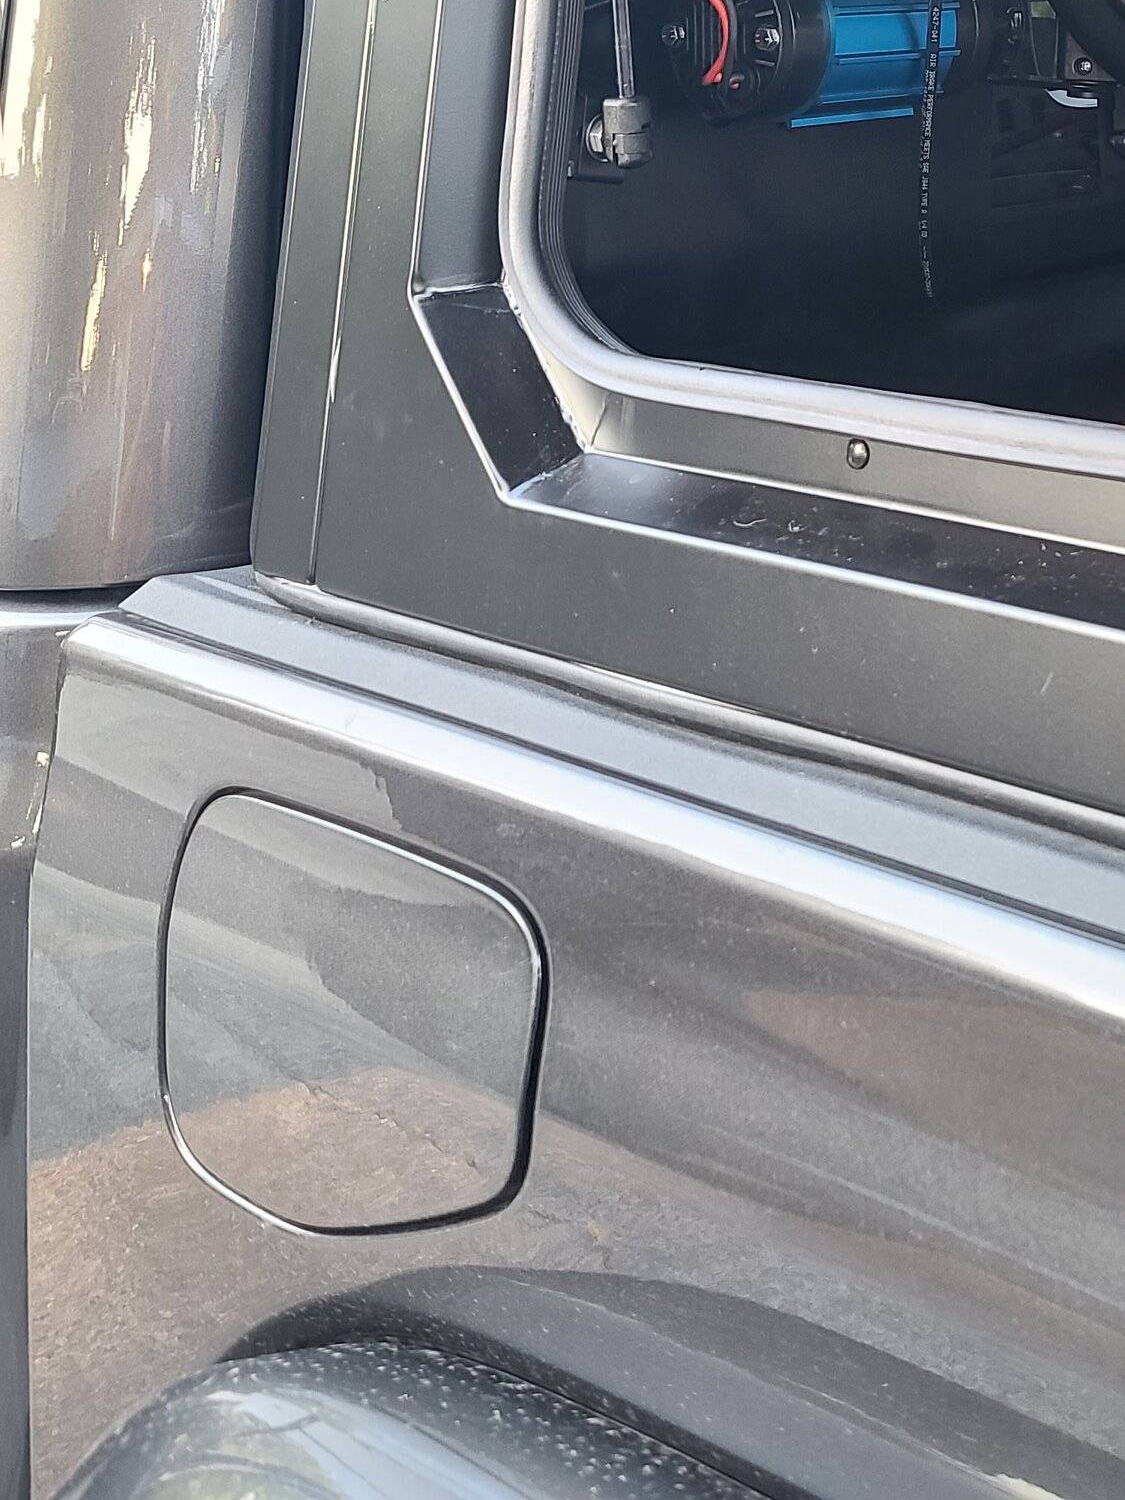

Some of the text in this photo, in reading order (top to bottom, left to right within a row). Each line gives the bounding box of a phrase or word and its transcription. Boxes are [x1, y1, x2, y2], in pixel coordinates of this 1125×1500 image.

[929, 53, 937, 68] AIR
[927, 70, 936, 92] BRAKE
[924, 94, 934, 137] PERFORMANCE
[922, 139, 931, 160] MEETS
